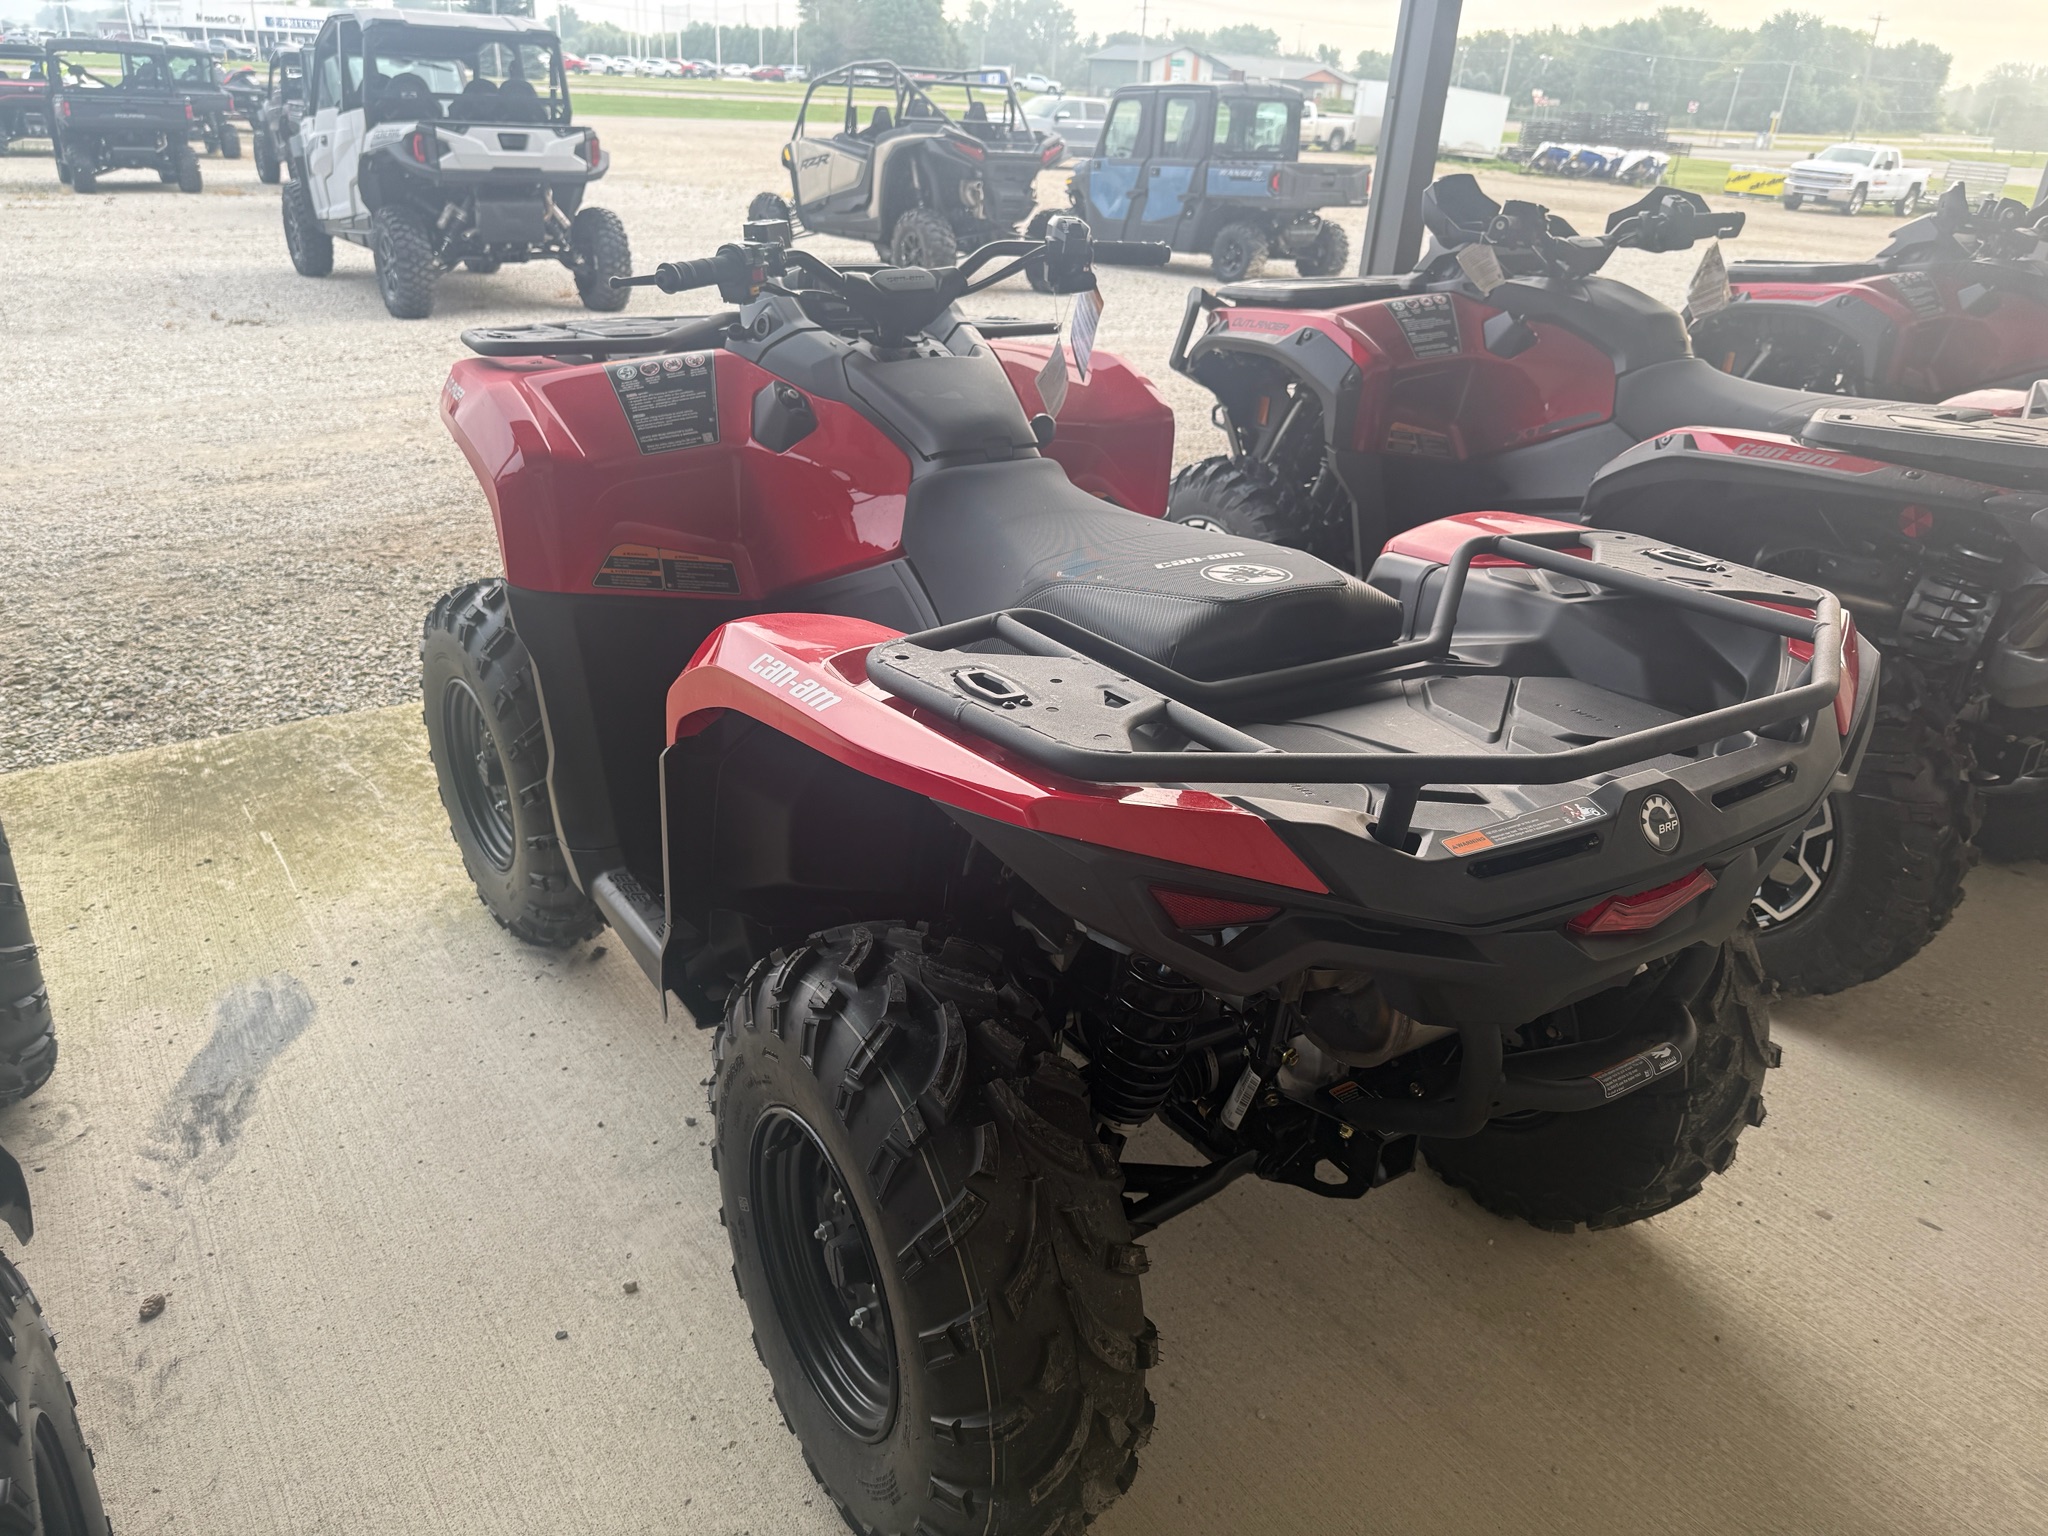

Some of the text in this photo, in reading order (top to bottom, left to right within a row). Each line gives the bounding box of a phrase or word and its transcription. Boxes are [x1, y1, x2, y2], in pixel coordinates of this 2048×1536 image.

[1231, 317, 1290, 332] OUTLANDER
[1733, 442, 1841, 466] can-am
[1154, 551, 1246, 570] can-am
[748, 653, 843, 712] can-am
[1658, 820, 1678, 834] BRP
[1457, 836, 1487, 848] WARNING
